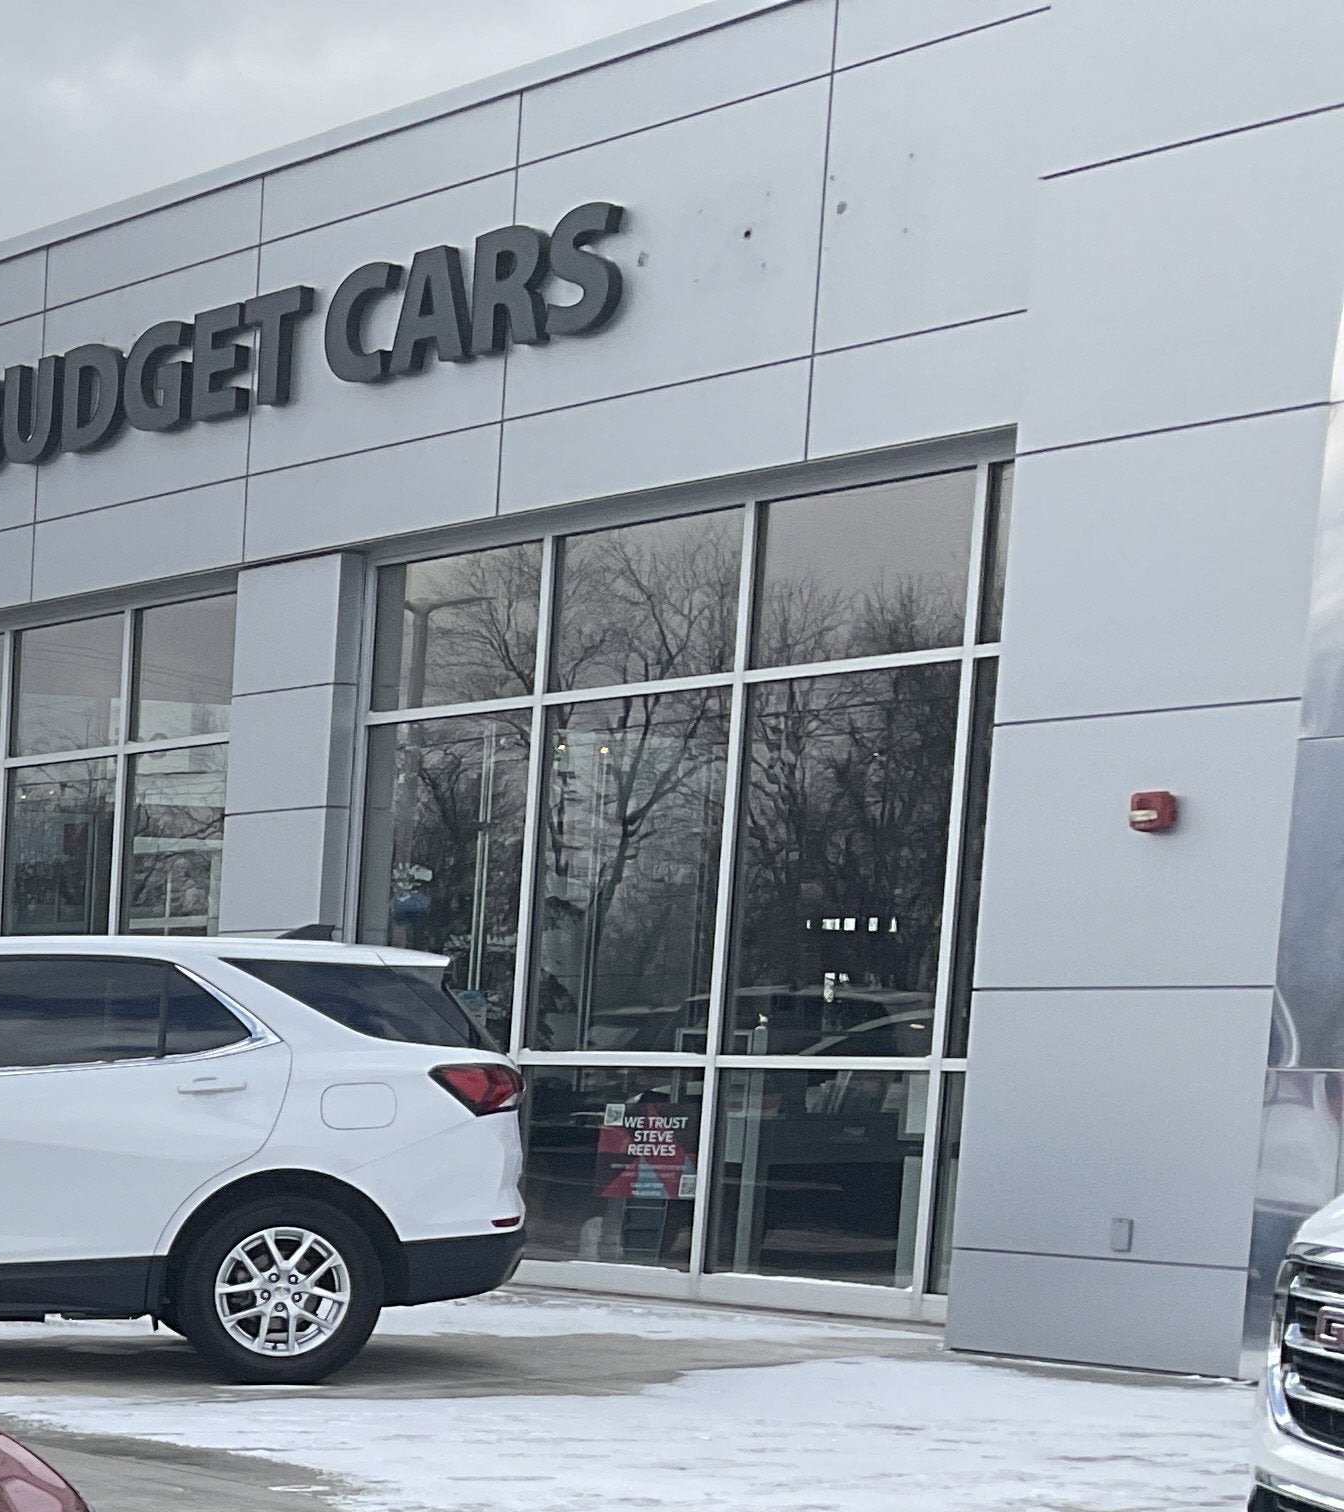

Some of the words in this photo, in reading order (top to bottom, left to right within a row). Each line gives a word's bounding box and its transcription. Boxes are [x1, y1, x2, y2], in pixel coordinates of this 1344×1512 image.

[325, 201, 624, 383] CARS
[624, 1116, 645, 1129] WE
[648, 1116, 688, 1129] TRUST
[633, 1130, 674, 1143] STEVE
[627, 1143, 676, 1157] REEVES
